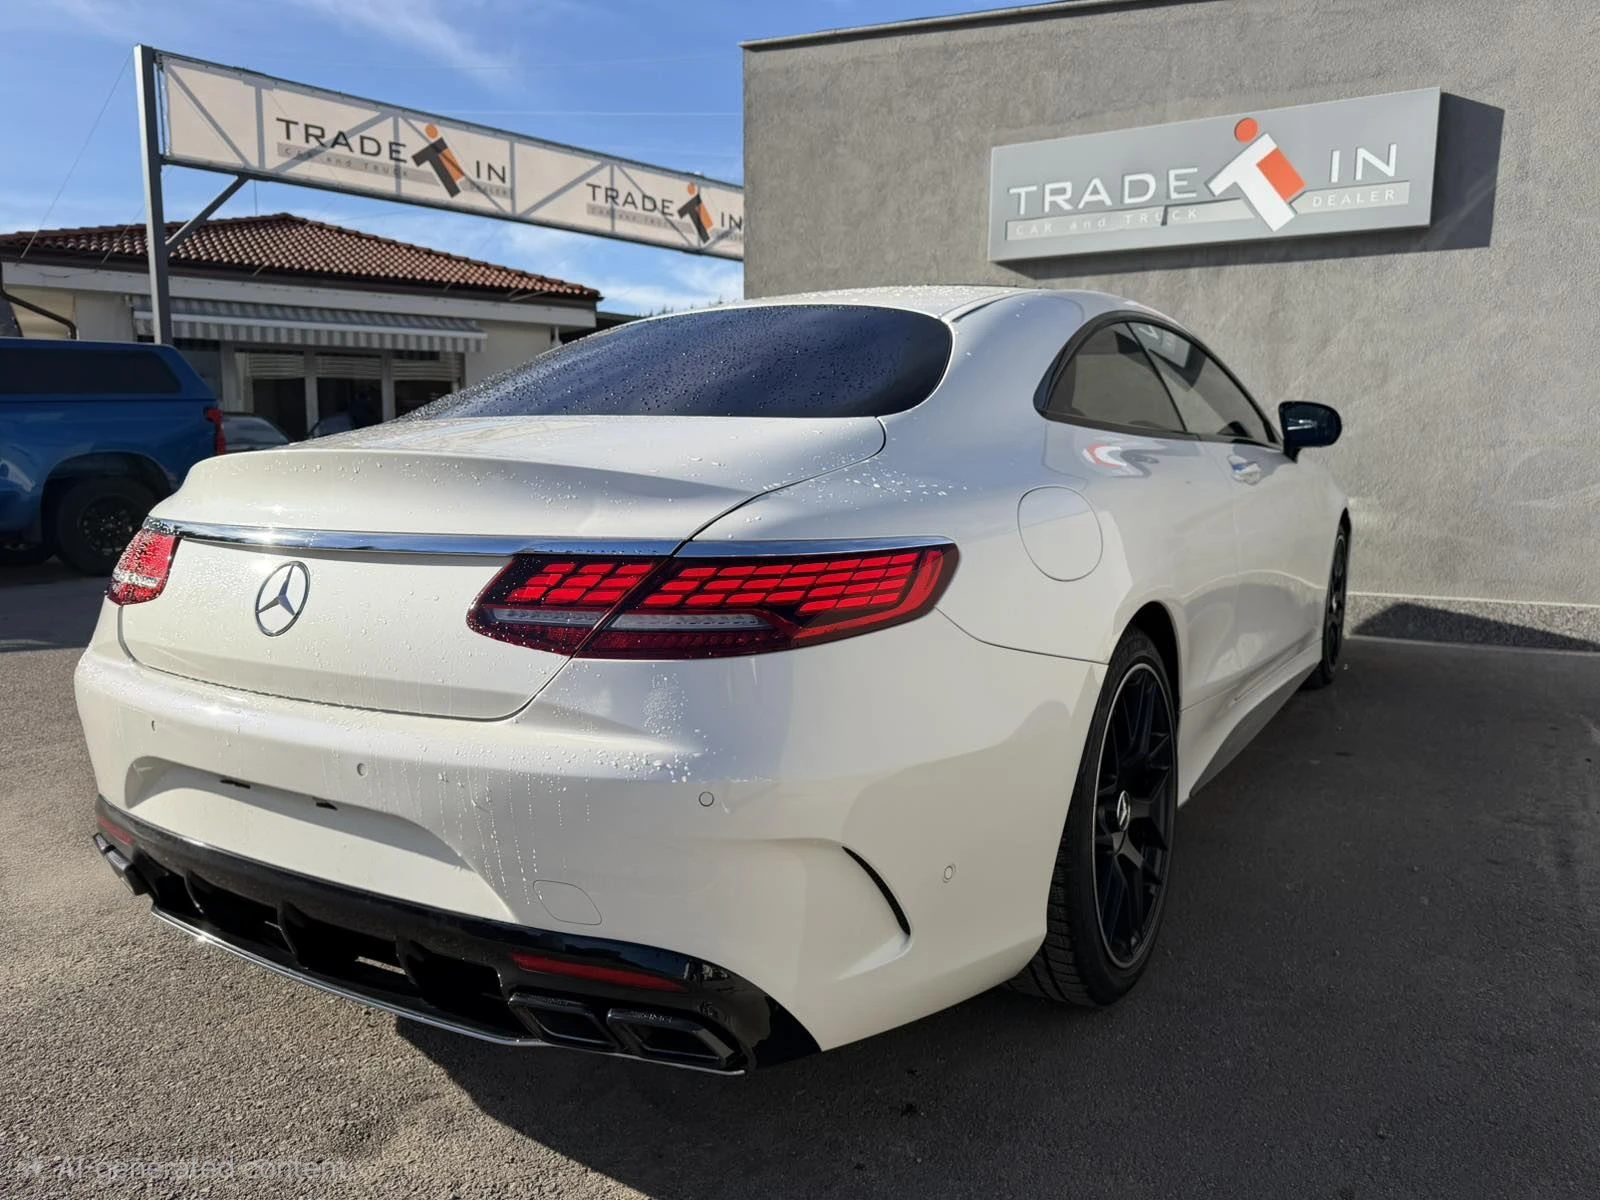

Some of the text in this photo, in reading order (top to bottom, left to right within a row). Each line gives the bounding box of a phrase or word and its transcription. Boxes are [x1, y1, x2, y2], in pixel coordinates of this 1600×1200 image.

[276, 117, 408, 163] TRADE
[476, 160, 506, 184] IN
[1008, 167, 1199, 216] TRADE
[1330, 143, 1398, 183] IN
[1312, 188, 1396, 209] DEALER
[586, 182, 674, 217] TRADE
[720, 212, 743, 231] IN
[1015, 222, 1053, 236] CAR
[1069, 217, 1106, 232] and
